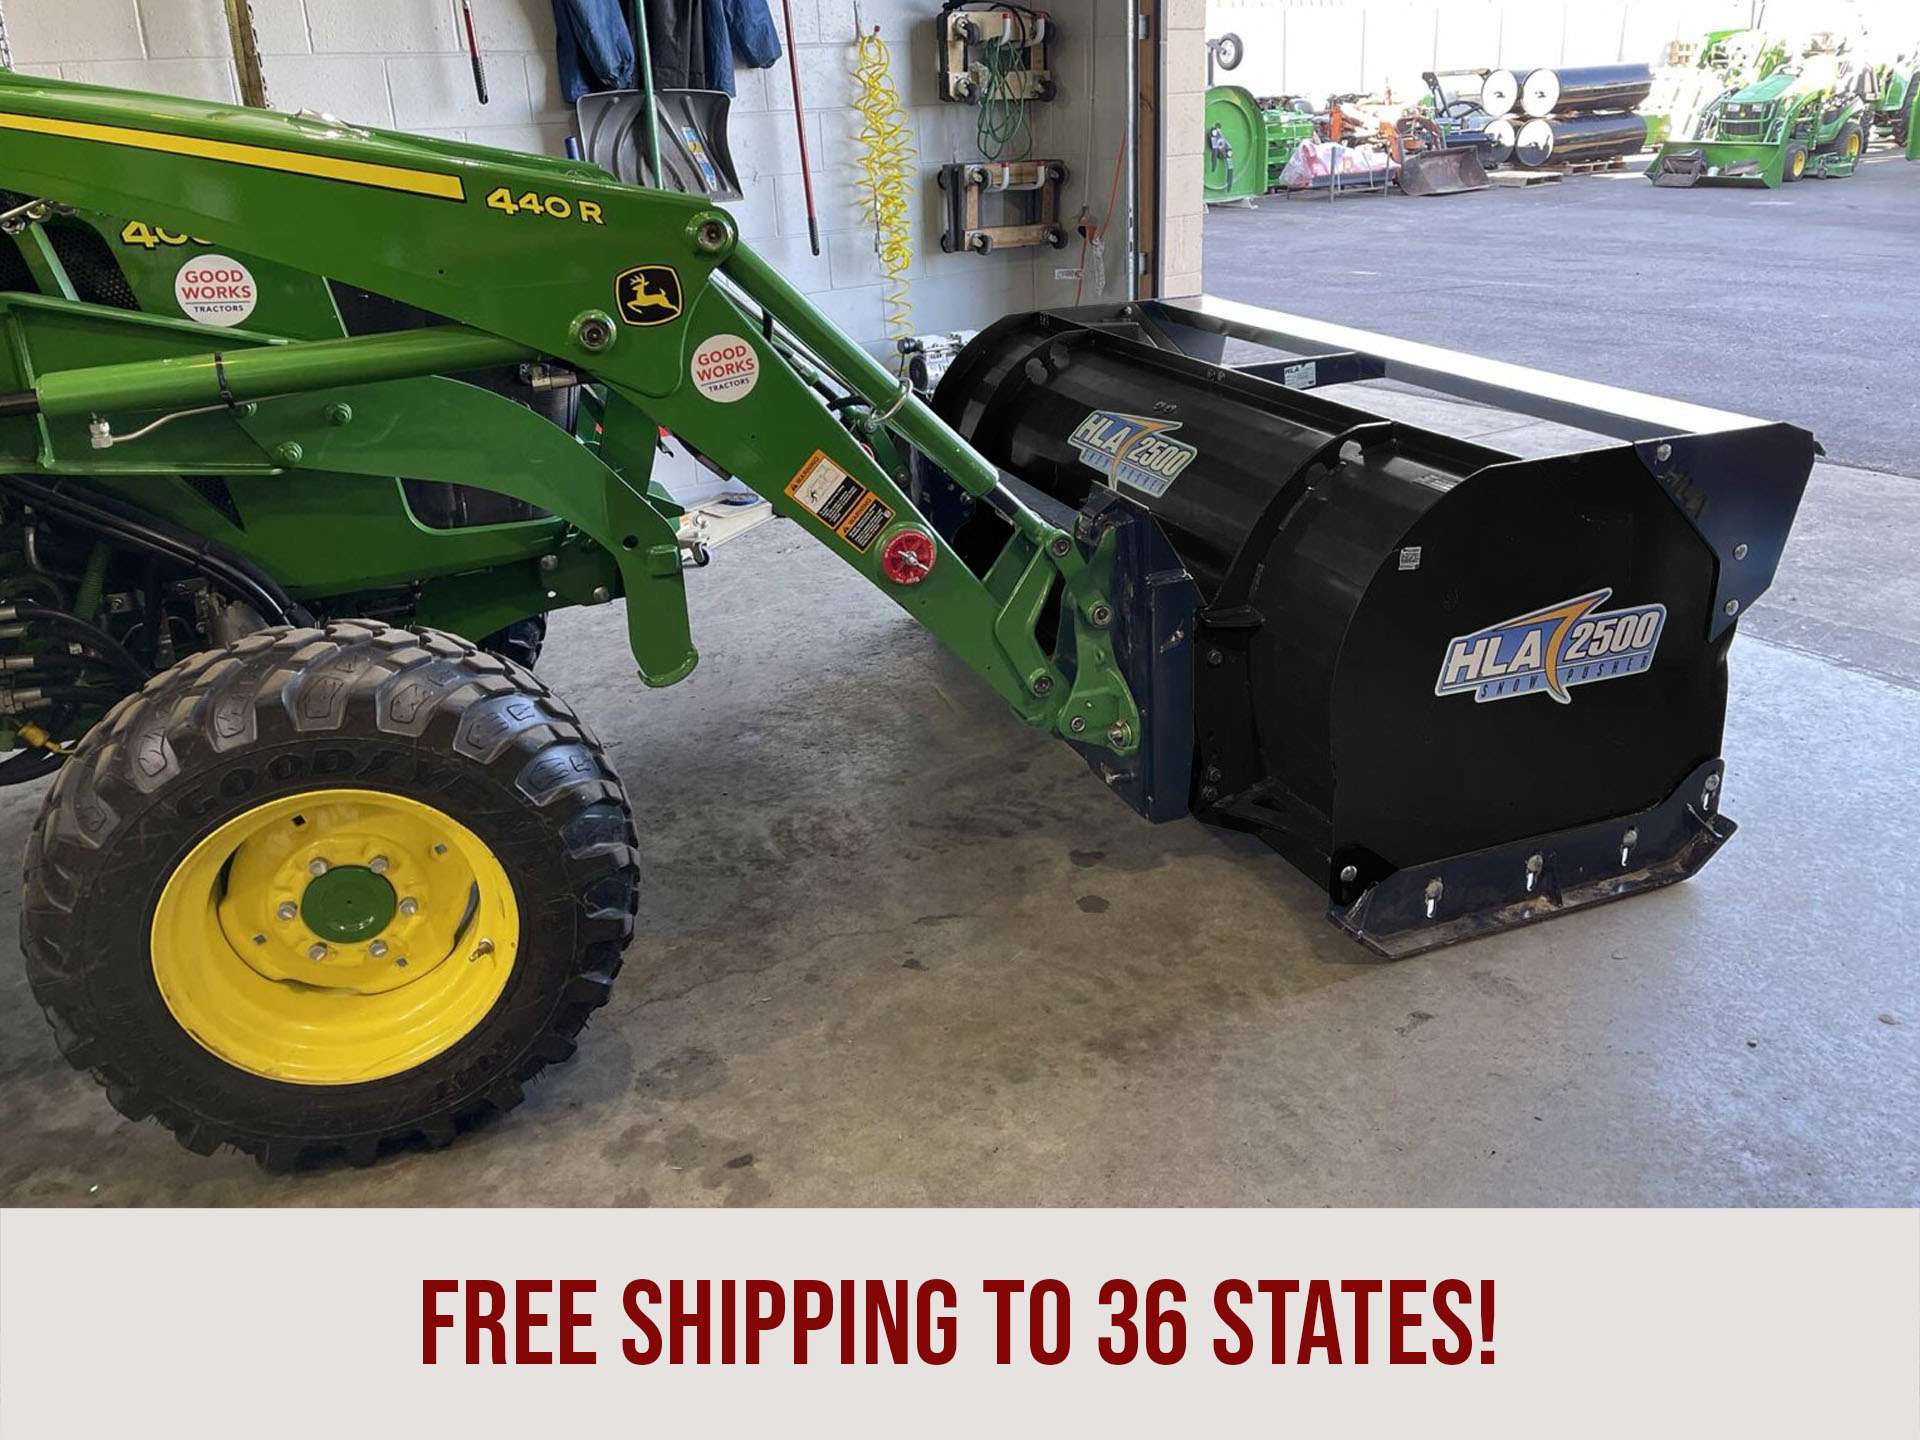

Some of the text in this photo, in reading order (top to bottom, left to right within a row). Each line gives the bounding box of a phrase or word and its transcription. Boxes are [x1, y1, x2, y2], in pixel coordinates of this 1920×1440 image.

[486, 188, 606, 225] 440 R
[184, 270, 244, 284] GOOD
[181, 285, 251, 300] WORKS
[193, 304, 244, 313] TRACTORS
[697, 345, 747, 366] GOOD
[696, 357, 755, 382] WORKS
[708, 377, 750, 392] TRACTORS
[1074, 413, 1193, 476] HLA 2500
[1443, 610, 1662, 685] HLA 2500
[1480, 655, 1649, 698] SNOW PUSHER
